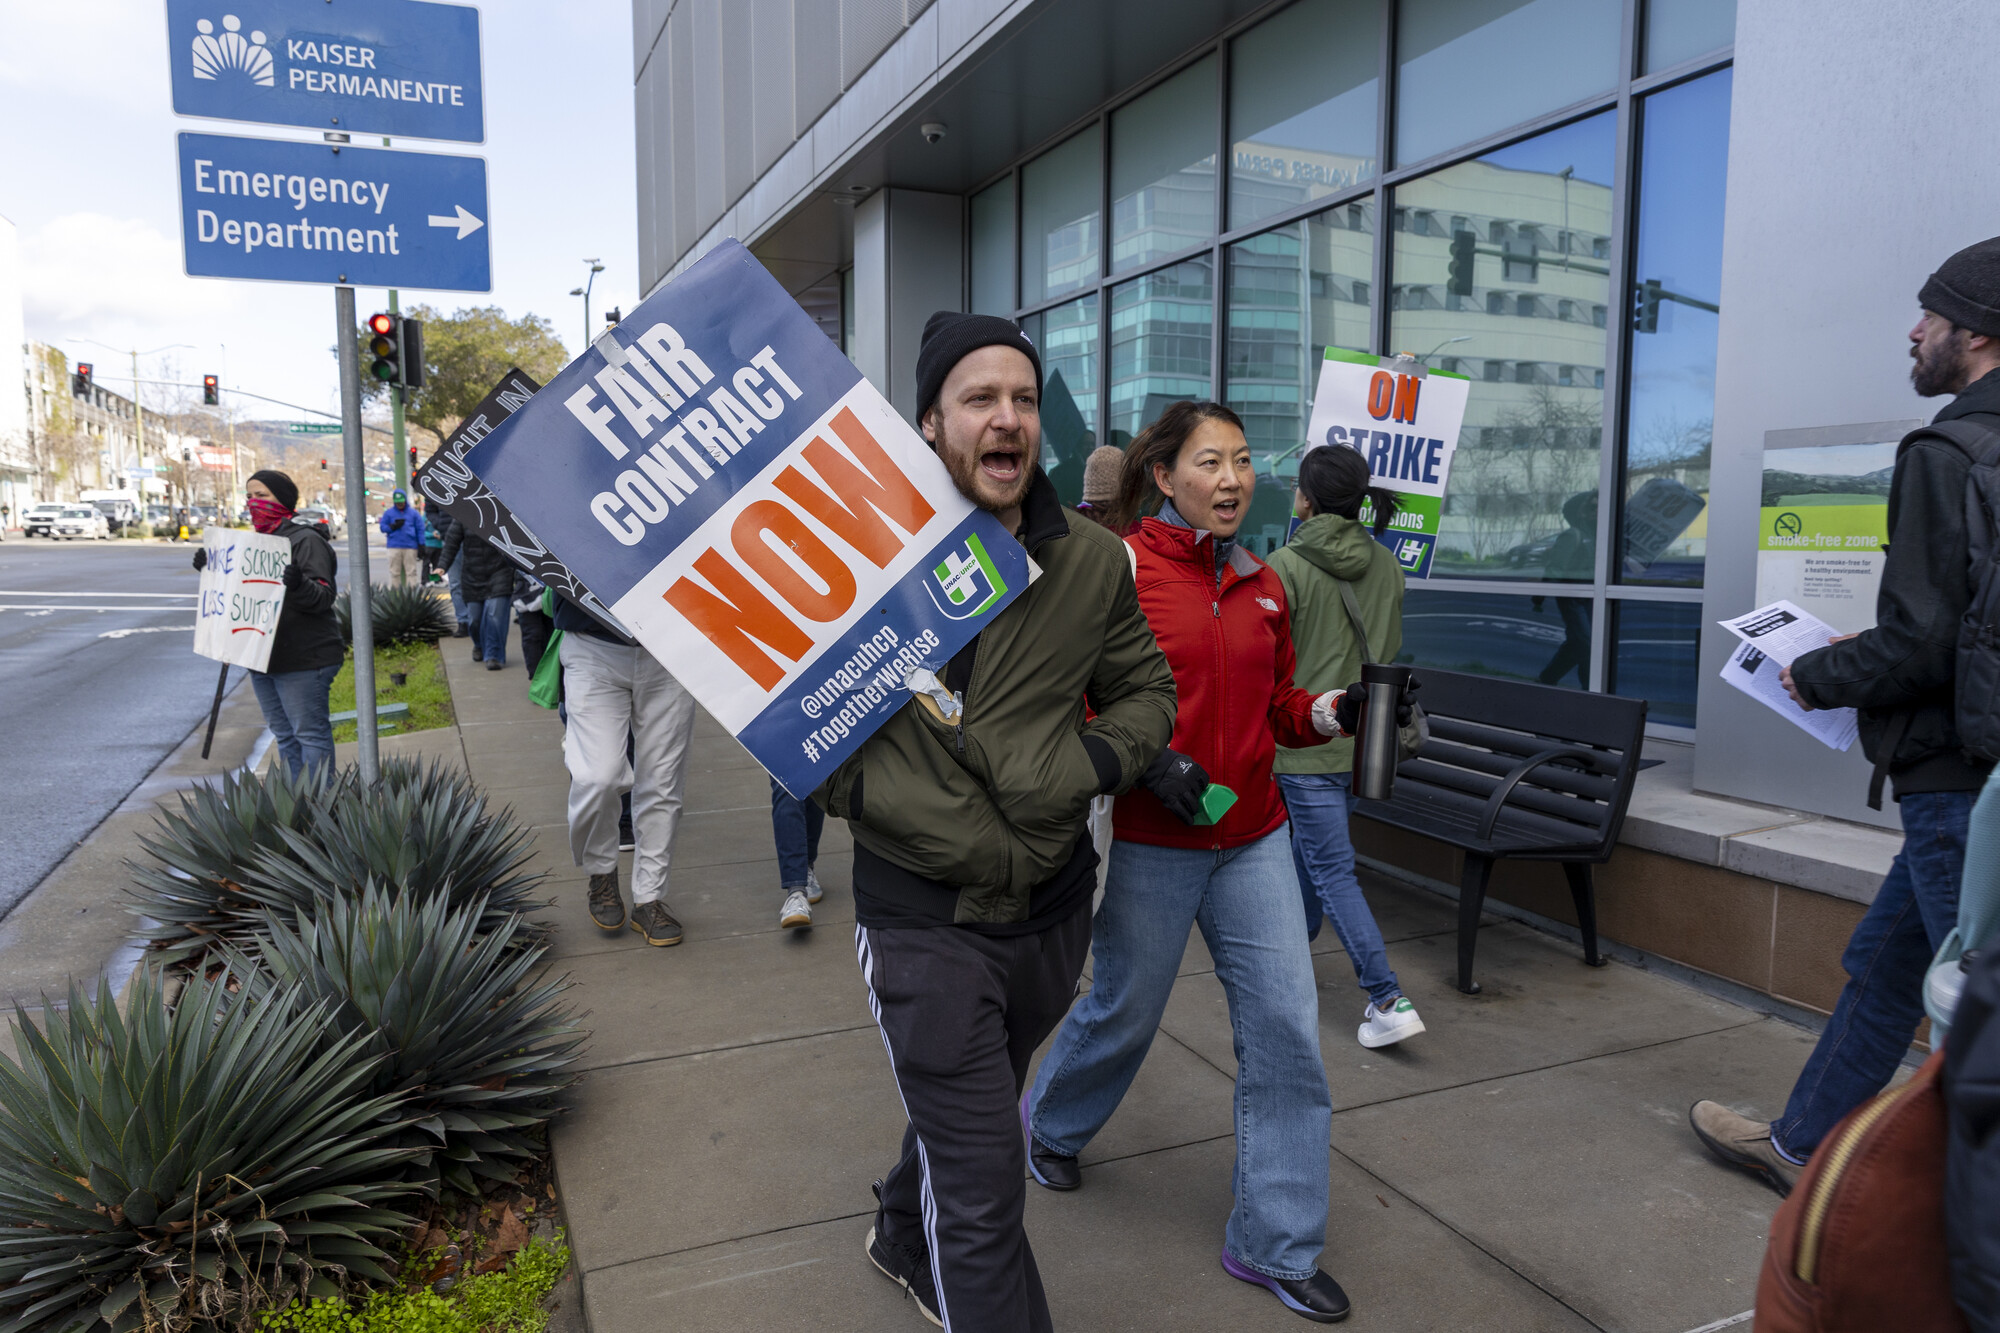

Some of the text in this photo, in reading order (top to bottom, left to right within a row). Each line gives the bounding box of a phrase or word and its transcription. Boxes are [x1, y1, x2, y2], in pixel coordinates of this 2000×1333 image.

[287, 39, 376, 69] KAISER
[289, 69, 464, 106] PERMANENTE
[195, 159, 390, 215] Emergency
[197, 209, 400, 255] Department
[564, 321, 716, 461] FAIR
[1367, 370, 1421, 426] ON
[589, 344, 804, 547] CONTRACT
[661, 405, 938, 693] NOW
[1767, 532, 1878, 548] smoke-free zone
[944, 558, 977, 590] UNAC/UHCP
[800, 625, 899, 719] @unacuhcp
[801, 628, 940, 764] #TogetherWeRise
